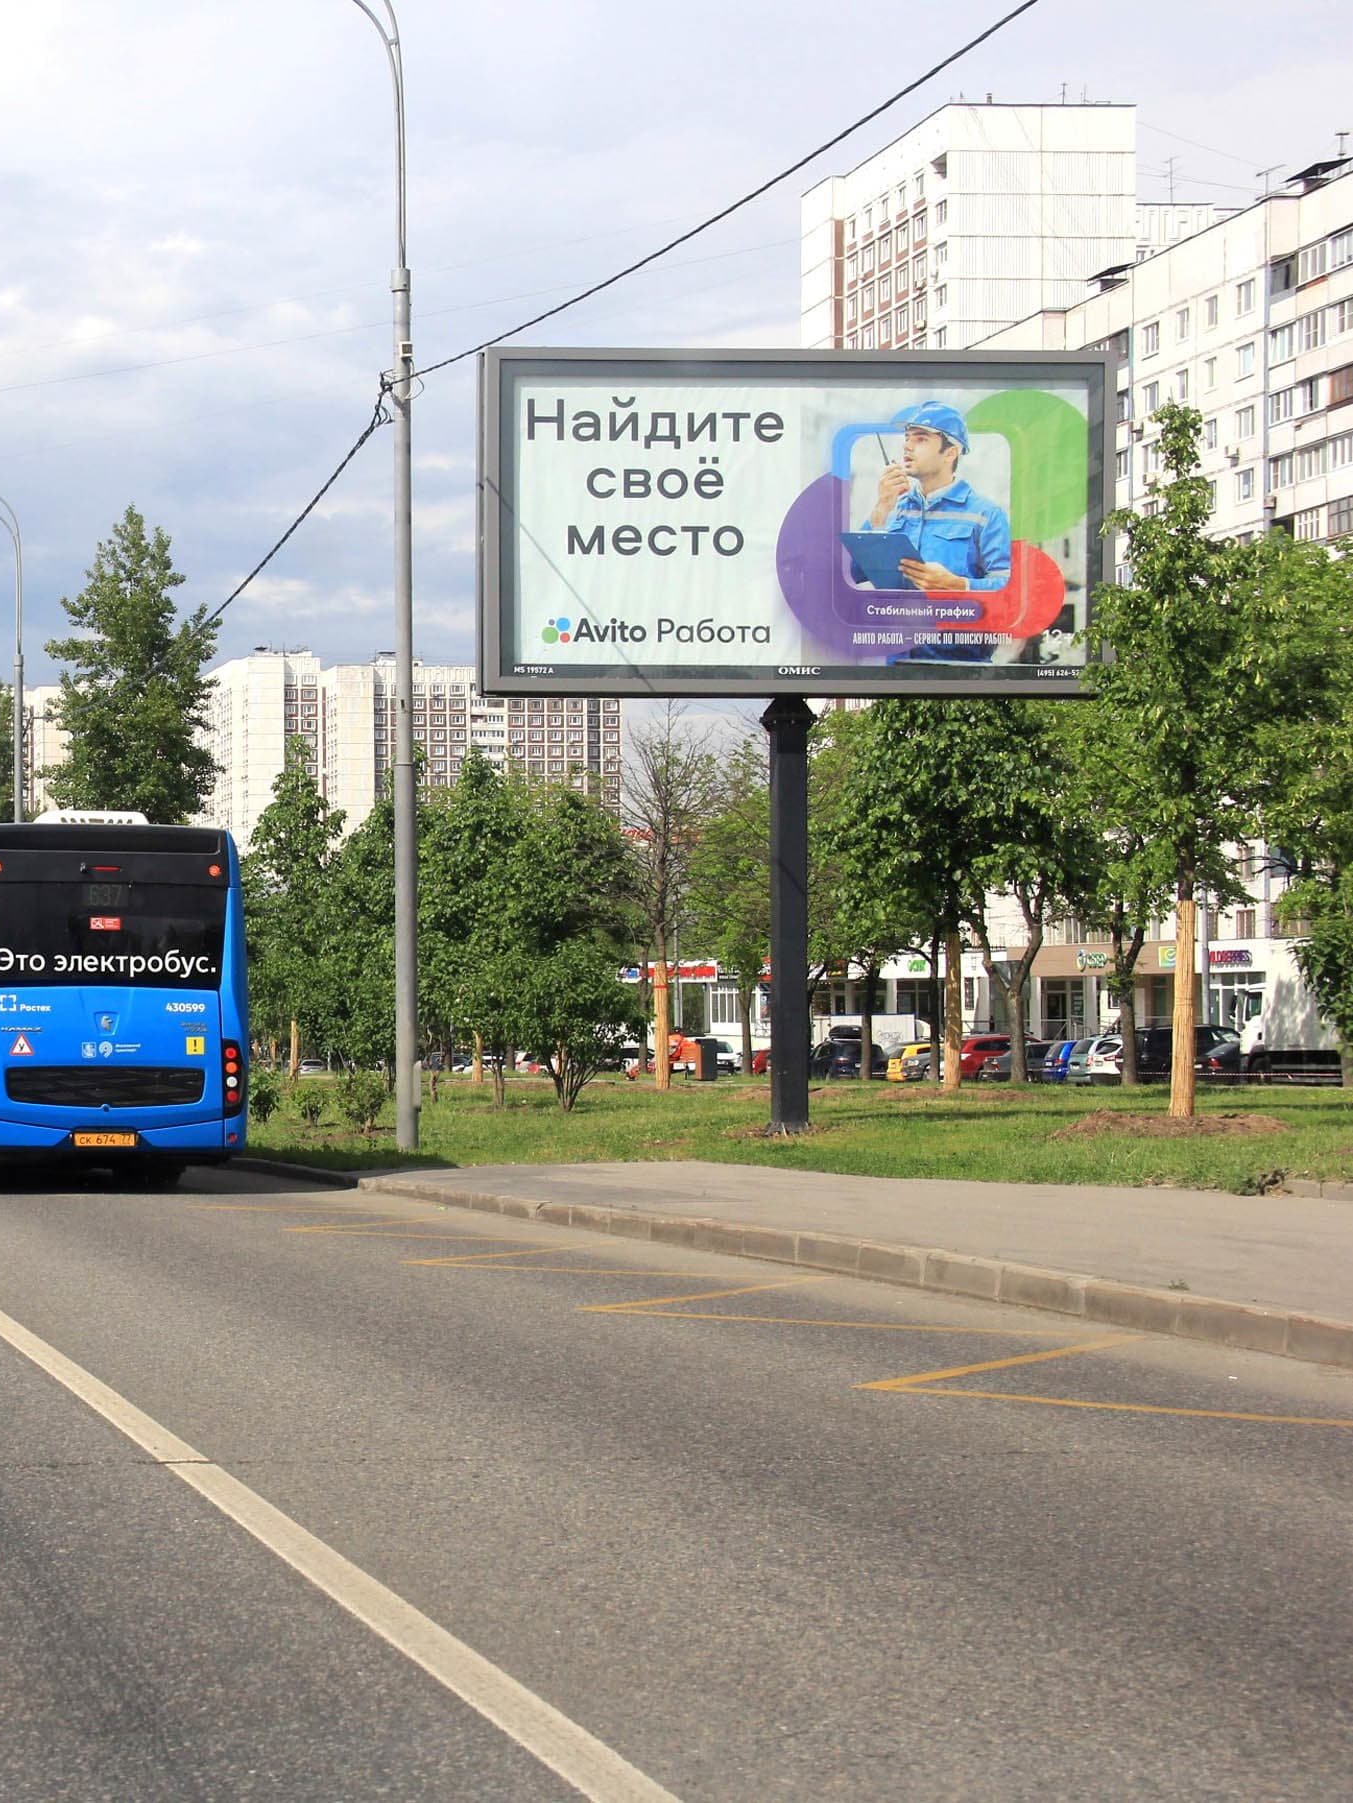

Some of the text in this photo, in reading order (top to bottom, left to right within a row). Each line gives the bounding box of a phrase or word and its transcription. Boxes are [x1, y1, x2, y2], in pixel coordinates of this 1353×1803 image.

[527, 396, 785, 450] Найдите
[586, 456, 724, 499] своё
[567, 525, 745, 556] место
[866, 605, 975, 618] Стабильный график
[573, 618, 771, 643] Avito Работа
[852, 632, 876, 645] АВИТО
[877, 632, 904, 645] РАБОТА
[913, 633, 941, 645] СЕРВИС
[943, 633, 953, 645] ПО
[954, 633, 983, 645] ПОИСКУ
[984, 633, 1013, 645] РАБОТЫ
[778, 666, 821, 675] ОМИС
[53, 949, 217, 978] электробус.
[19, 1003, 52, 1012] Ростех
[165, 1003, 206, 1013] 430599
[95, 1135, 116, 1145] 674
